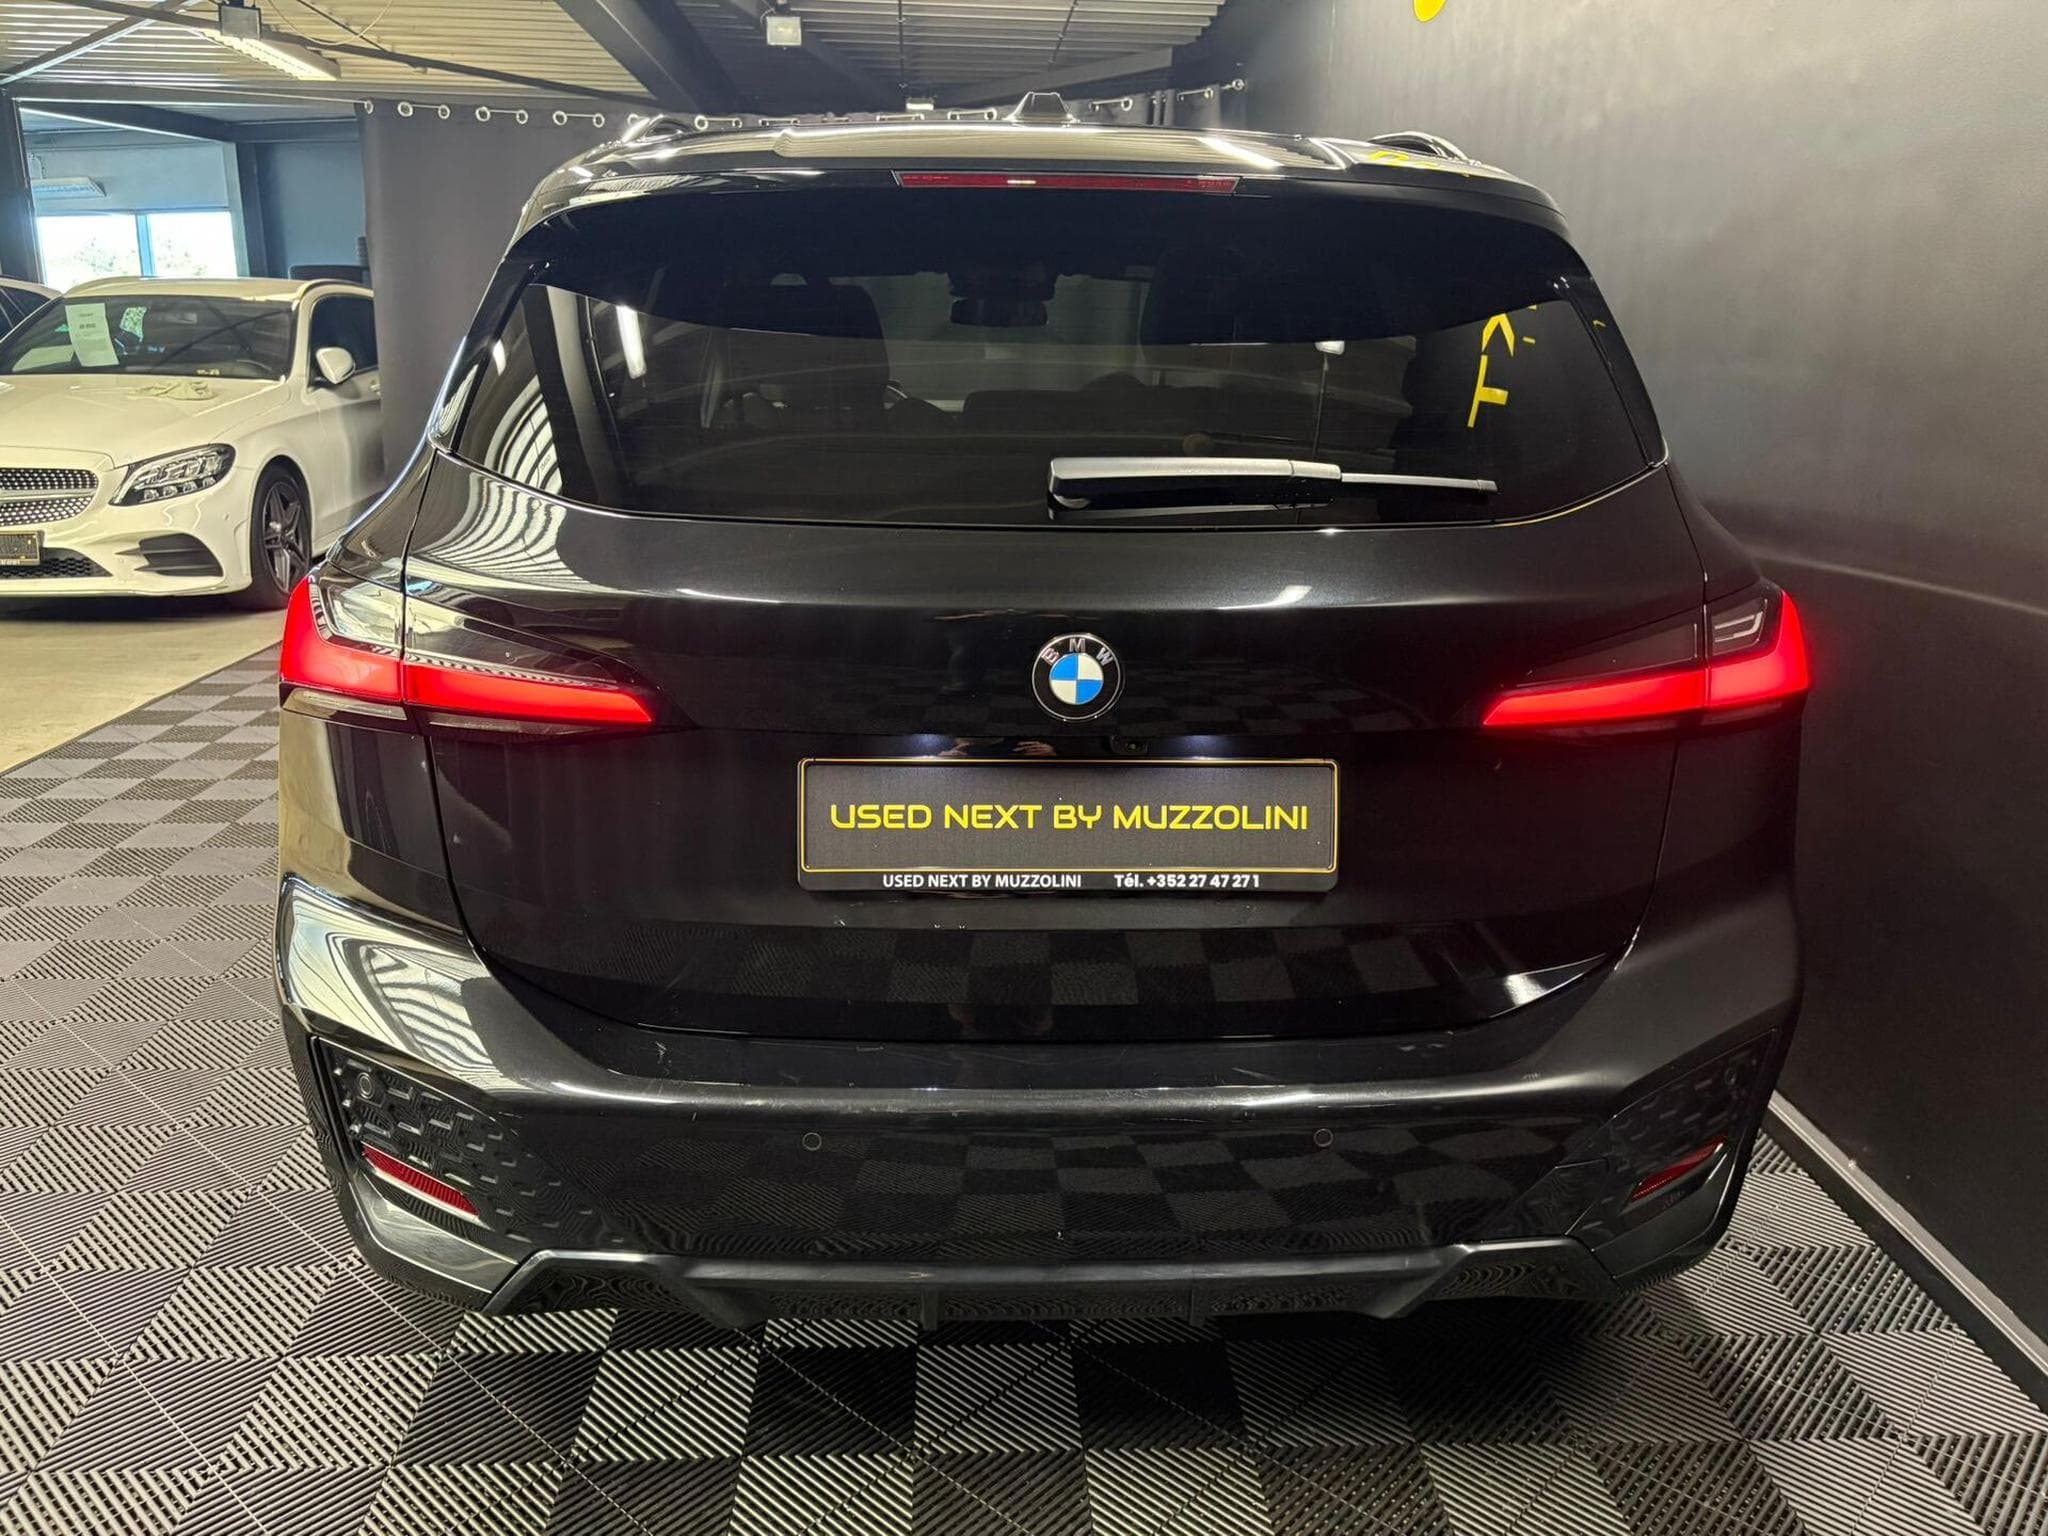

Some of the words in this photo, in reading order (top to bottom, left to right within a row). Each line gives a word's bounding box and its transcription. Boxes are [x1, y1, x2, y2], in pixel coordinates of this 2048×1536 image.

[1041, 638, 1114, 667] BMW
[830, 804, 933, 831] USED
[943, 804, 1042, 831] NEXT
[1053, 804, 1104, 831] BY
[1113, 804, 1309, 831] MUZZOLINI
[882, 874, 925, 888] USED
[927, 873, 969, 888] NEXT
[971, 874, 992, 888] BY
[994, 874, 1082, 888] MUZZOLINI
[1113, 872, 1145, 888] Tél.
[1146, 873, 1187, 888] +352
[1188, 873, 1207, 888] 27
[1209, 873, 1230, 888] 47
